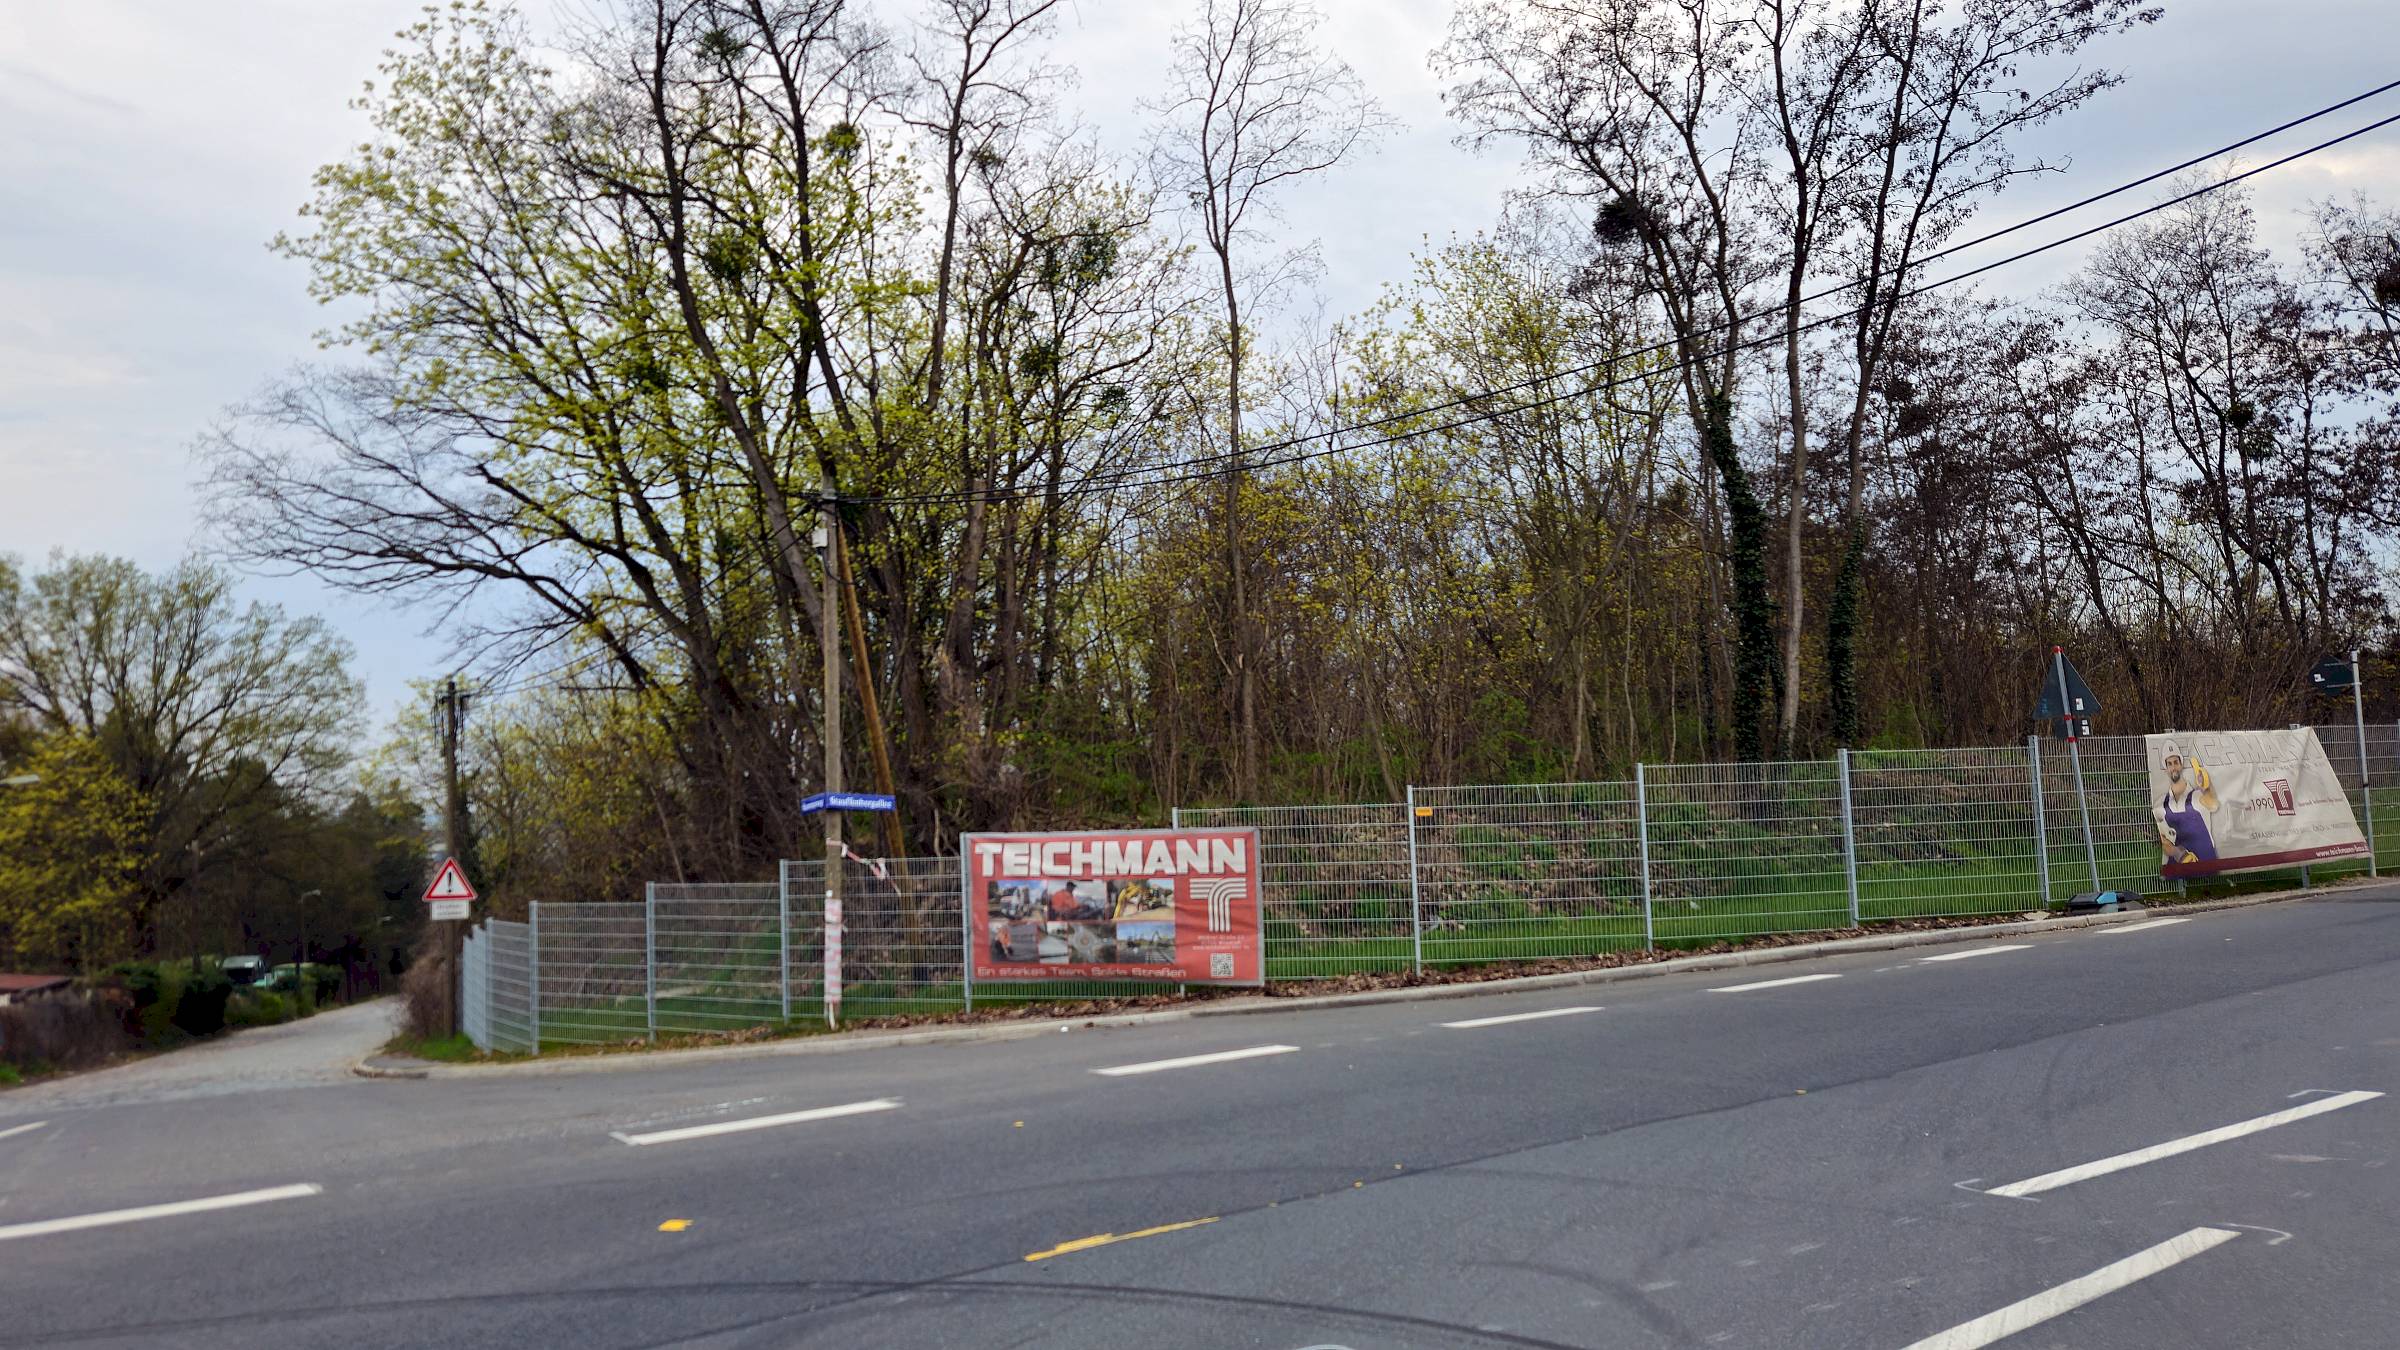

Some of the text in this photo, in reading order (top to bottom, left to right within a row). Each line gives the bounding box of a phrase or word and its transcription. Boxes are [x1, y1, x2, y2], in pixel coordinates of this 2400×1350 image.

[2250, 797, 2275, 811] 1990
[975, 838, 1247, 877] TEICHMANN
[977, 966, 996, 977] Ein
[999, 967, 1047, 977] starkes
[1131, 967, 1187, 978] Straßen
